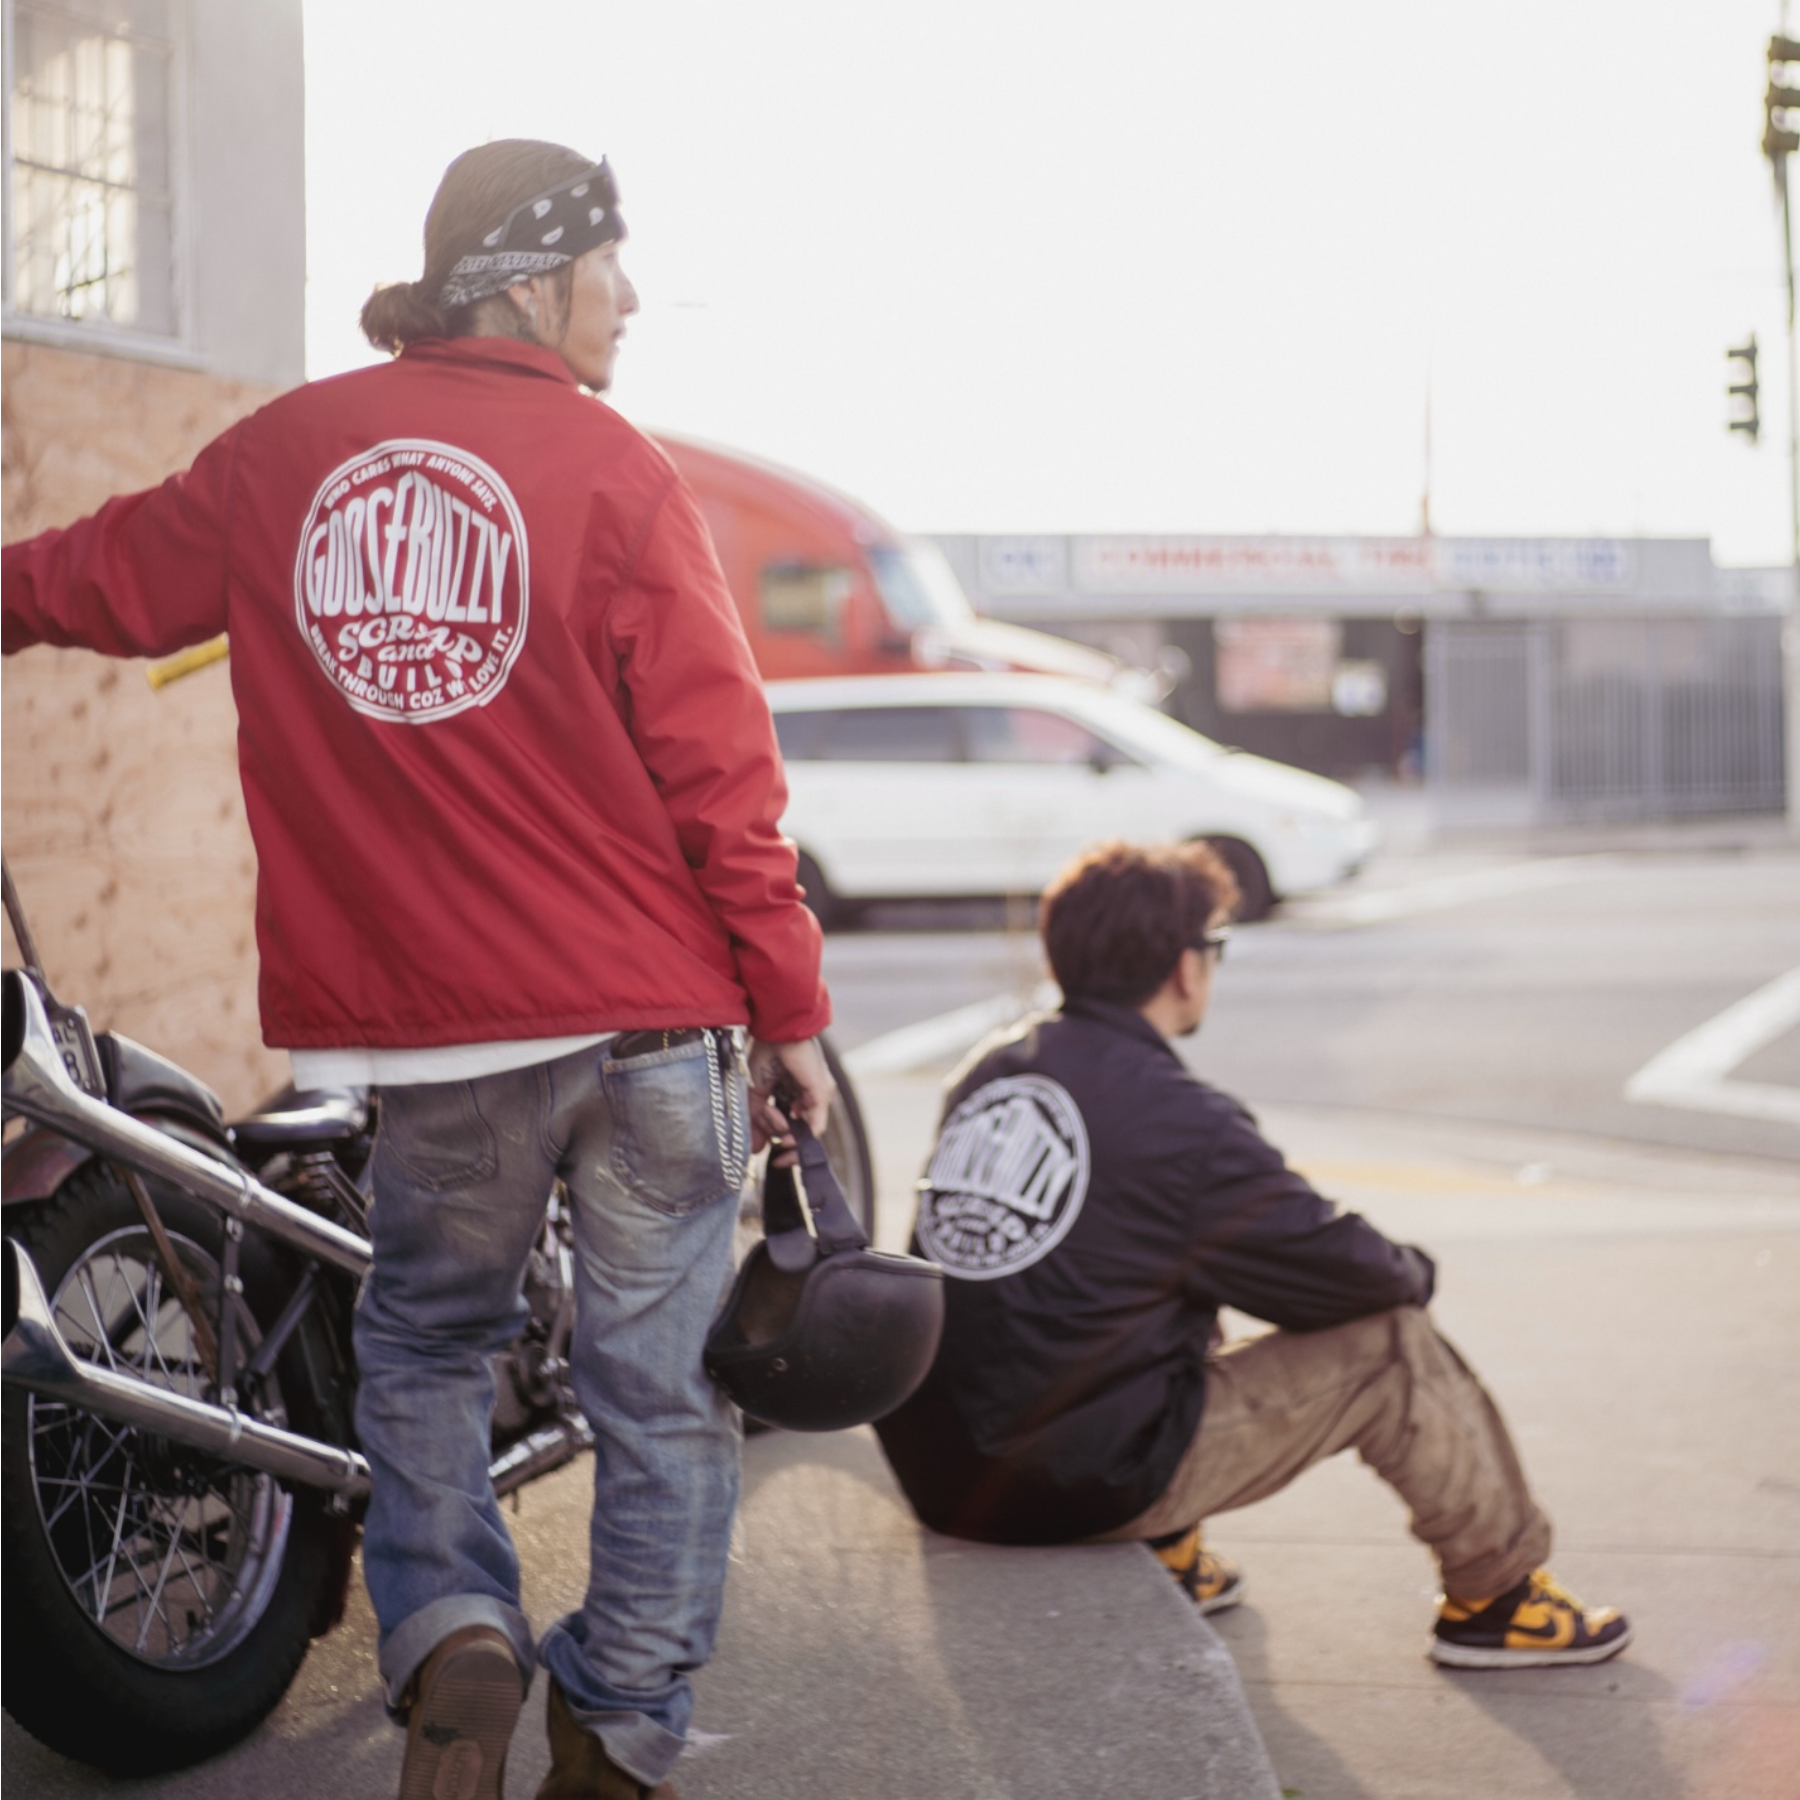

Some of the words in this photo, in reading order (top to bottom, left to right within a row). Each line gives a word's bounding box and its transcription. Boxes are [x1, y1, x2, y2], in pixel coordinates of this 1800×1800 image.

[323, 479, 351, 510] WHO
[351, 457, 391, 486] CARES
[391, 452, 425, 468] WHAT
[426, 455, 475, 486] ANYONE
[306, 470, 512, 624] GOOSEBUZZY
[310, 622, 338, 675] BREAK
[337, 663, 405, 710] THROUGH
[409, 689, 445, 710] COZ
[446, 679, 469, 698] W
[468, 651, 499, 692] LOVE
[338, 615, 483, 664] SCRAP
[377, 643, 435, 663] and
